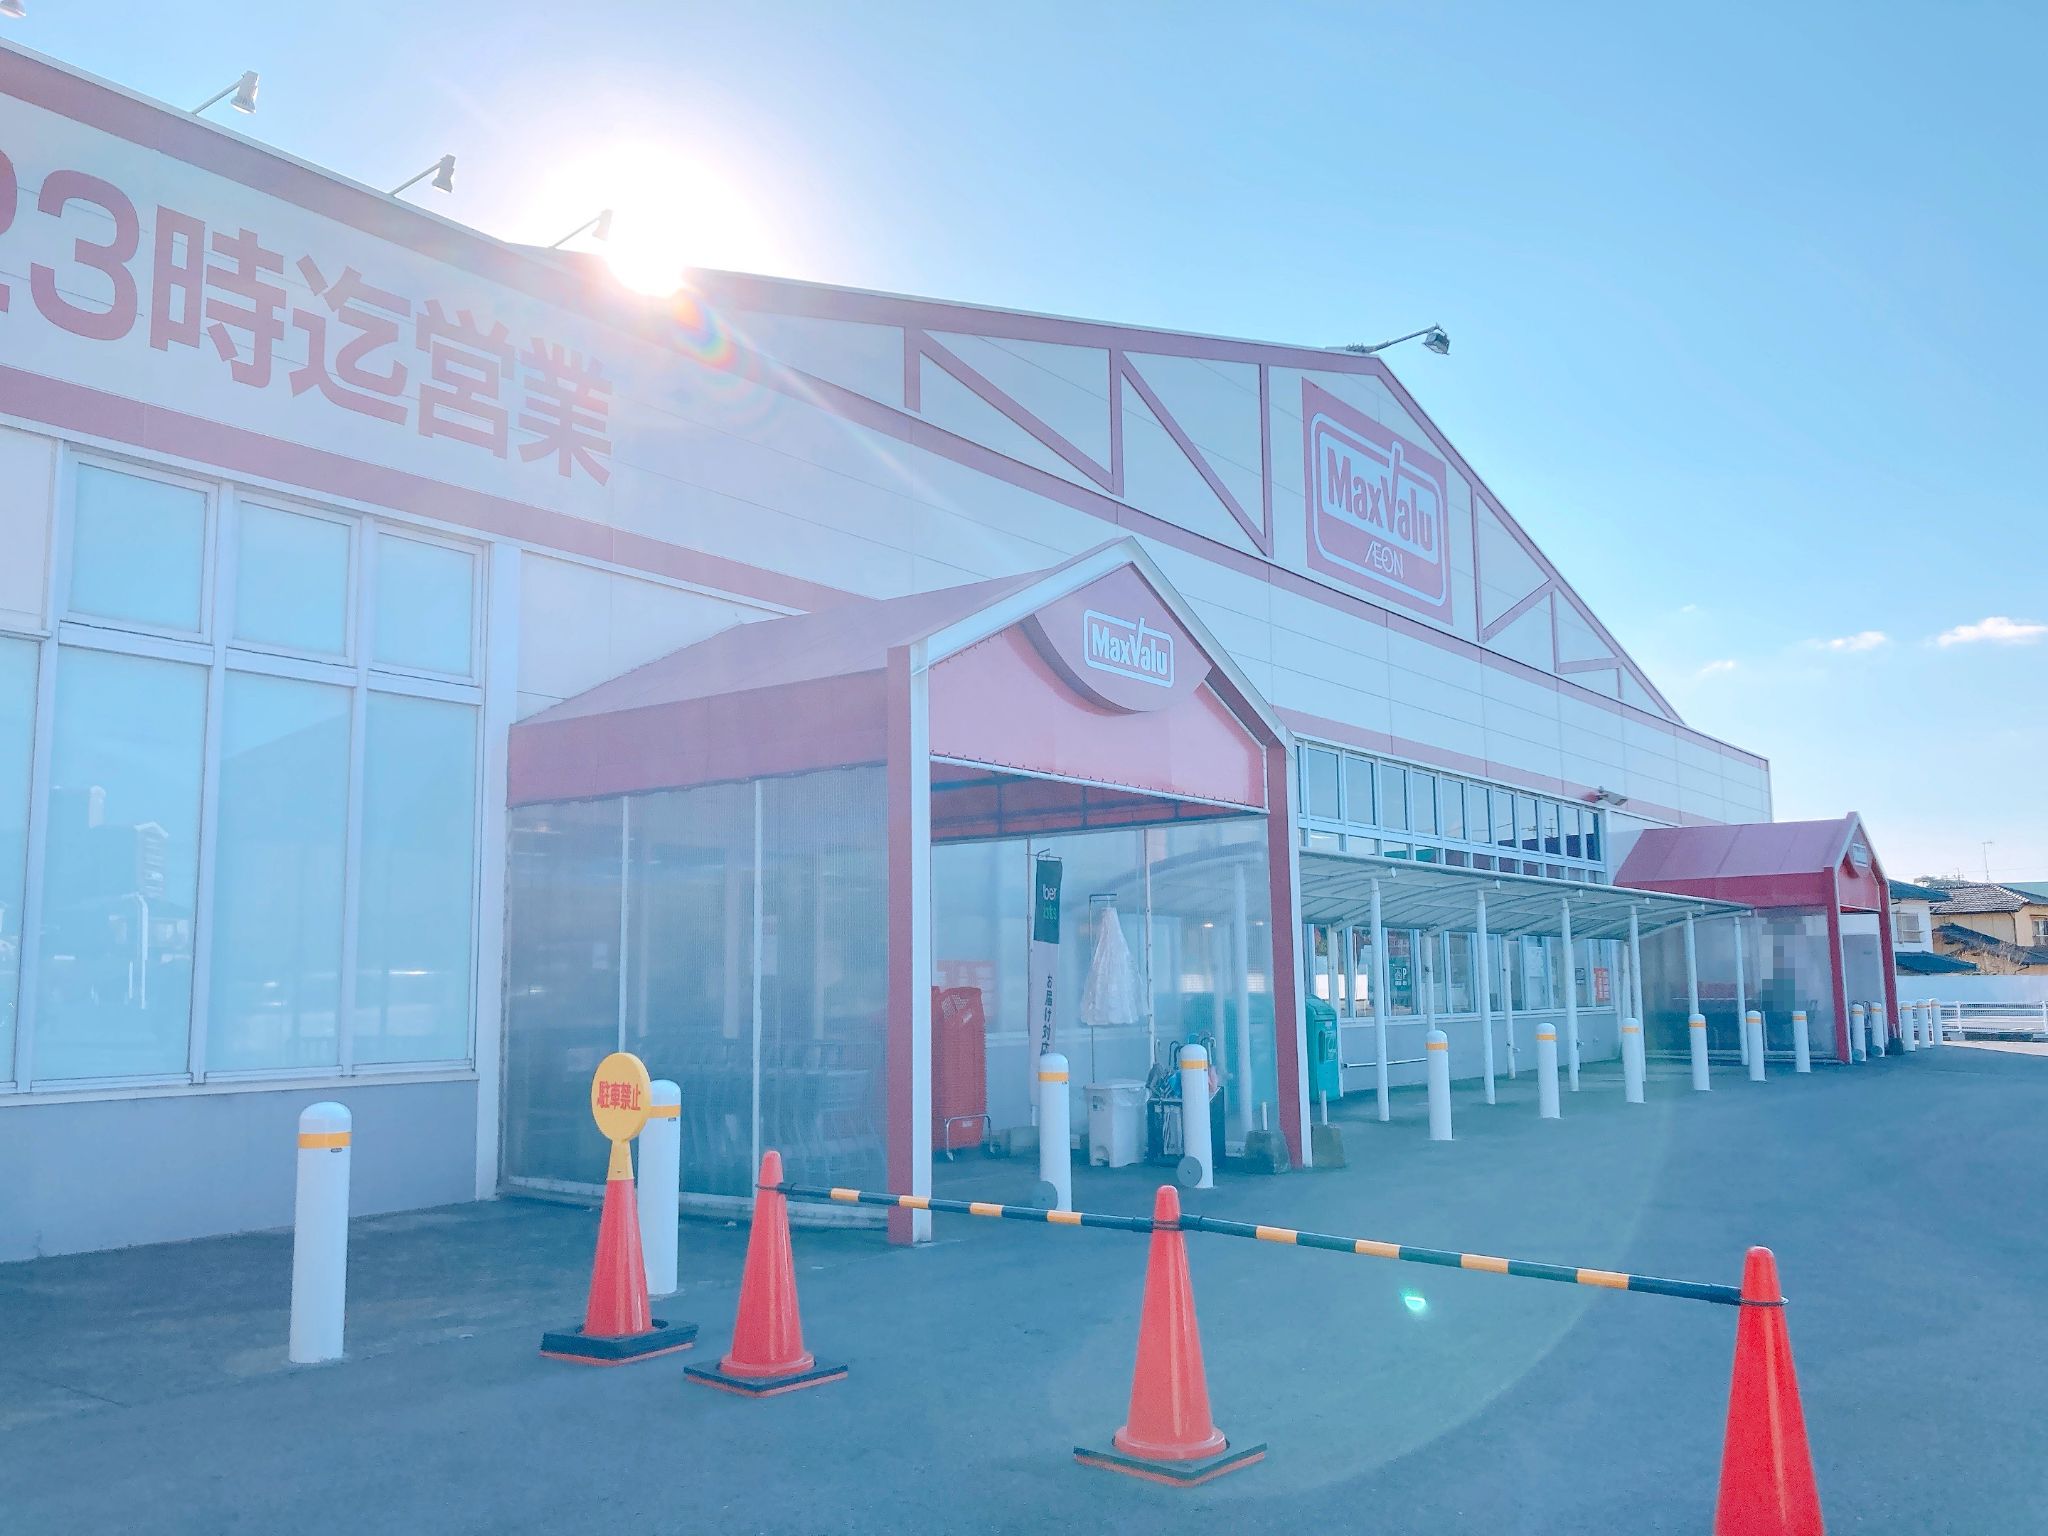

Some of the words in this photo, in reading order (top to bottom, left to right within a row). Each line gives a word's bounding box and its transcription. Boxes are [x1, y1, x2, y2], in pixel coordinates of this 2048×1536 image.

[0, 149, 612, 485] 3時迄営業
[1327, 446, 1433, 552] MaxValu
[1092, 617, 1168, 675] MaxValu
[597, 1080, 641, 1111] 駐車禁止
